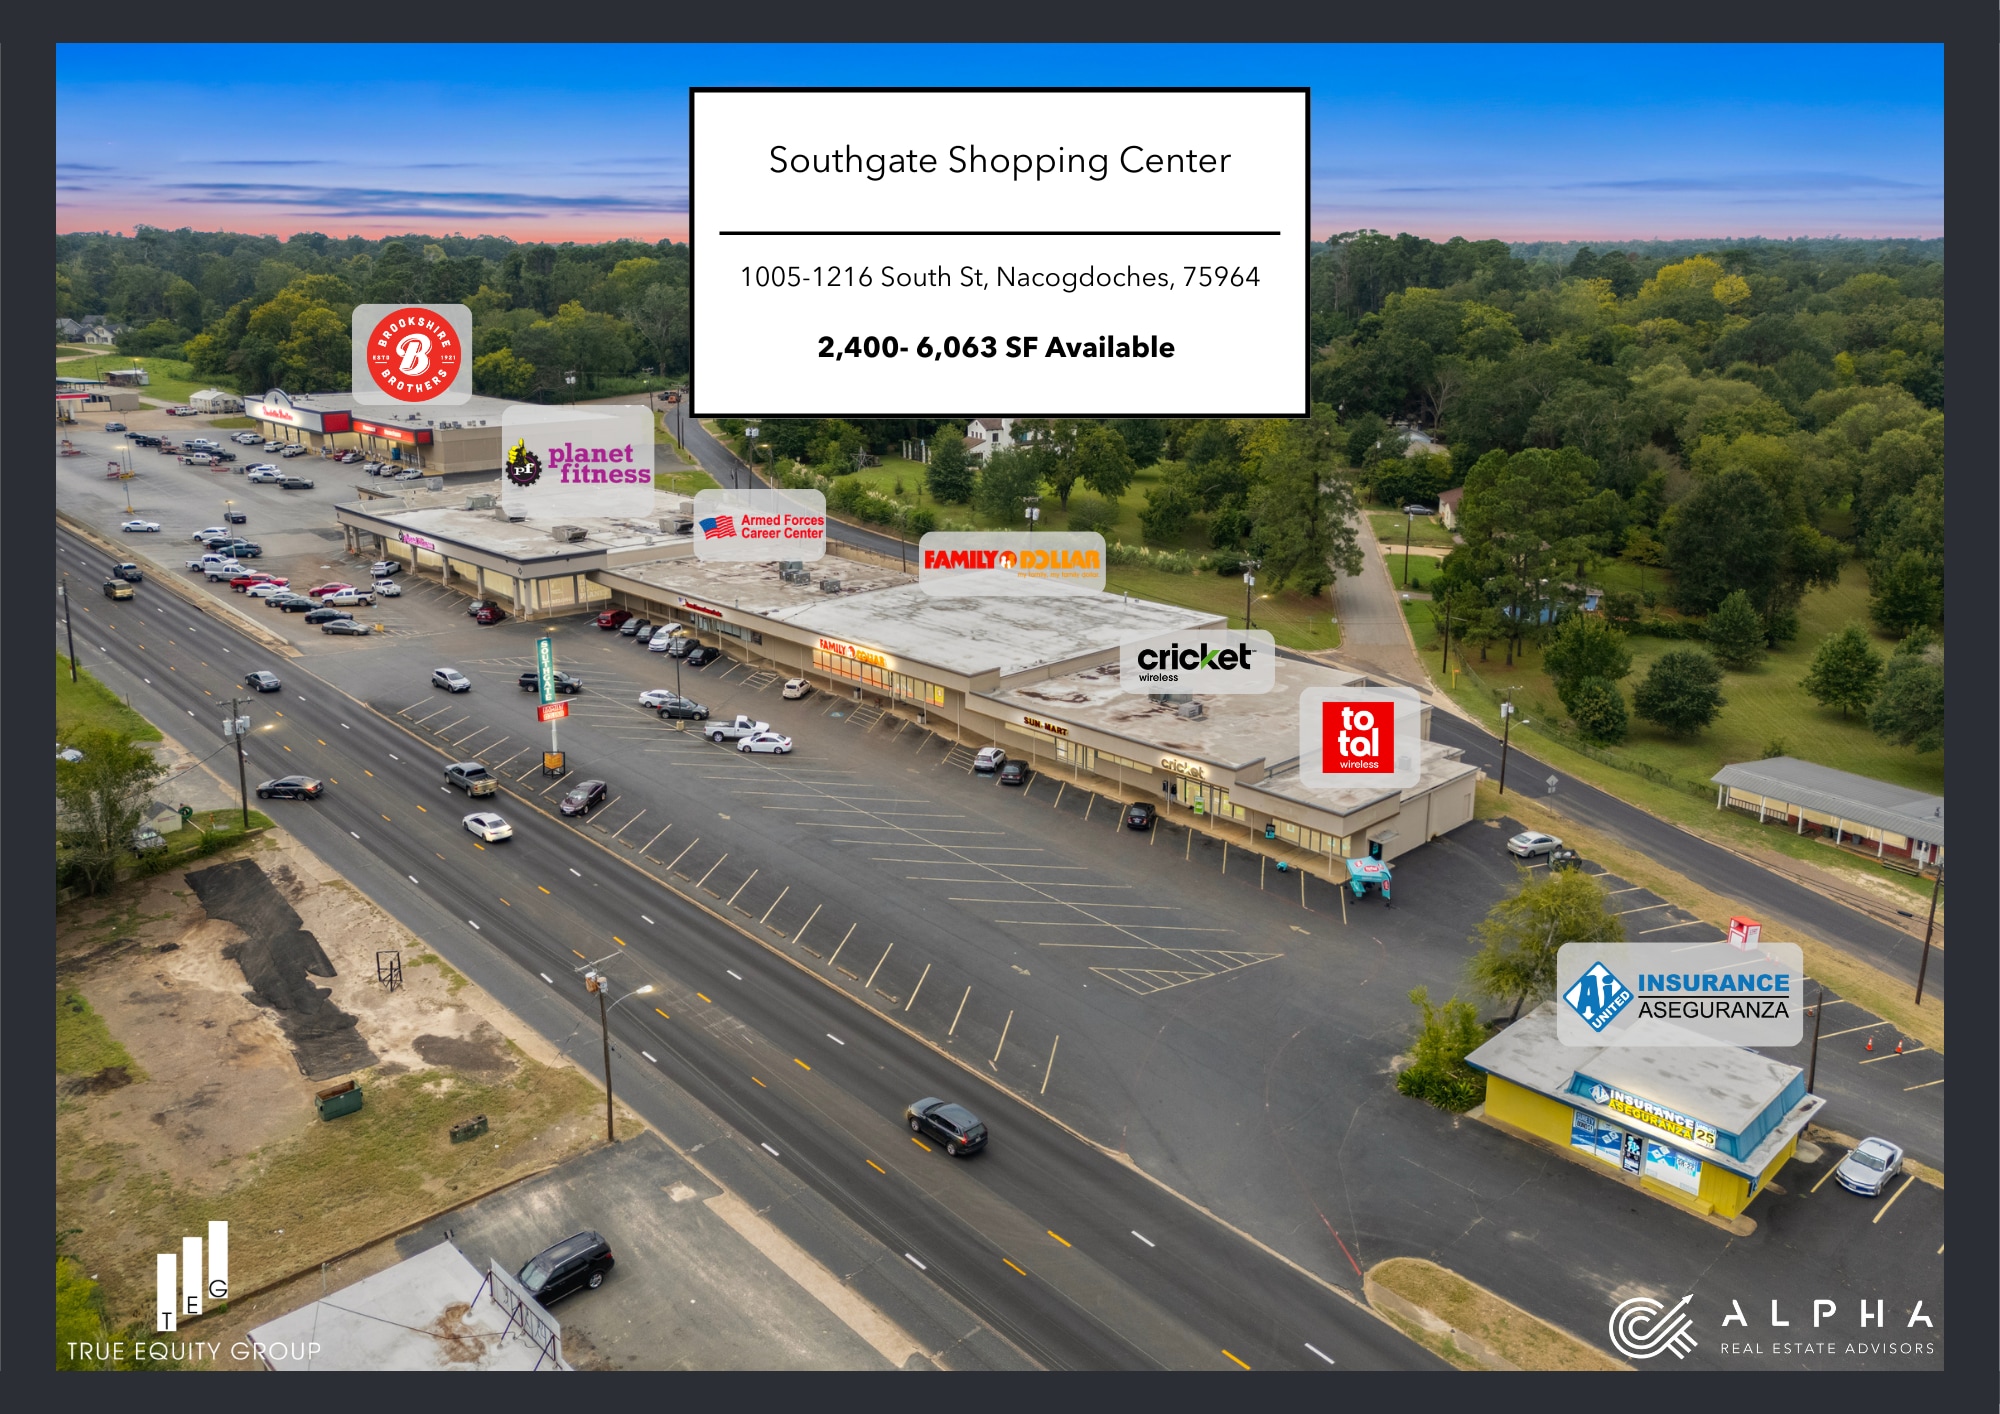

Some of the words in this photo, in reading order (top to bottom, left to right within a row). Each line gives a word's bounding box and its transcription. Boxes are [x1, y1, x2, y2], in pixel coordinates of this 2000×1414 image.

[819, 638, 847, 656] FAMILY
[540, 640, 553, 702] SOUTHGATE
[1044, 722, 1068, 736] MART
[1161, 758, 1205, 779] cricket
[1610, 1089, 1694, 1129] INSURANCE
[1608, 1099, 1693, 1141] ASEGURANZA
[1696, 1129, 1714, 1144] 25
